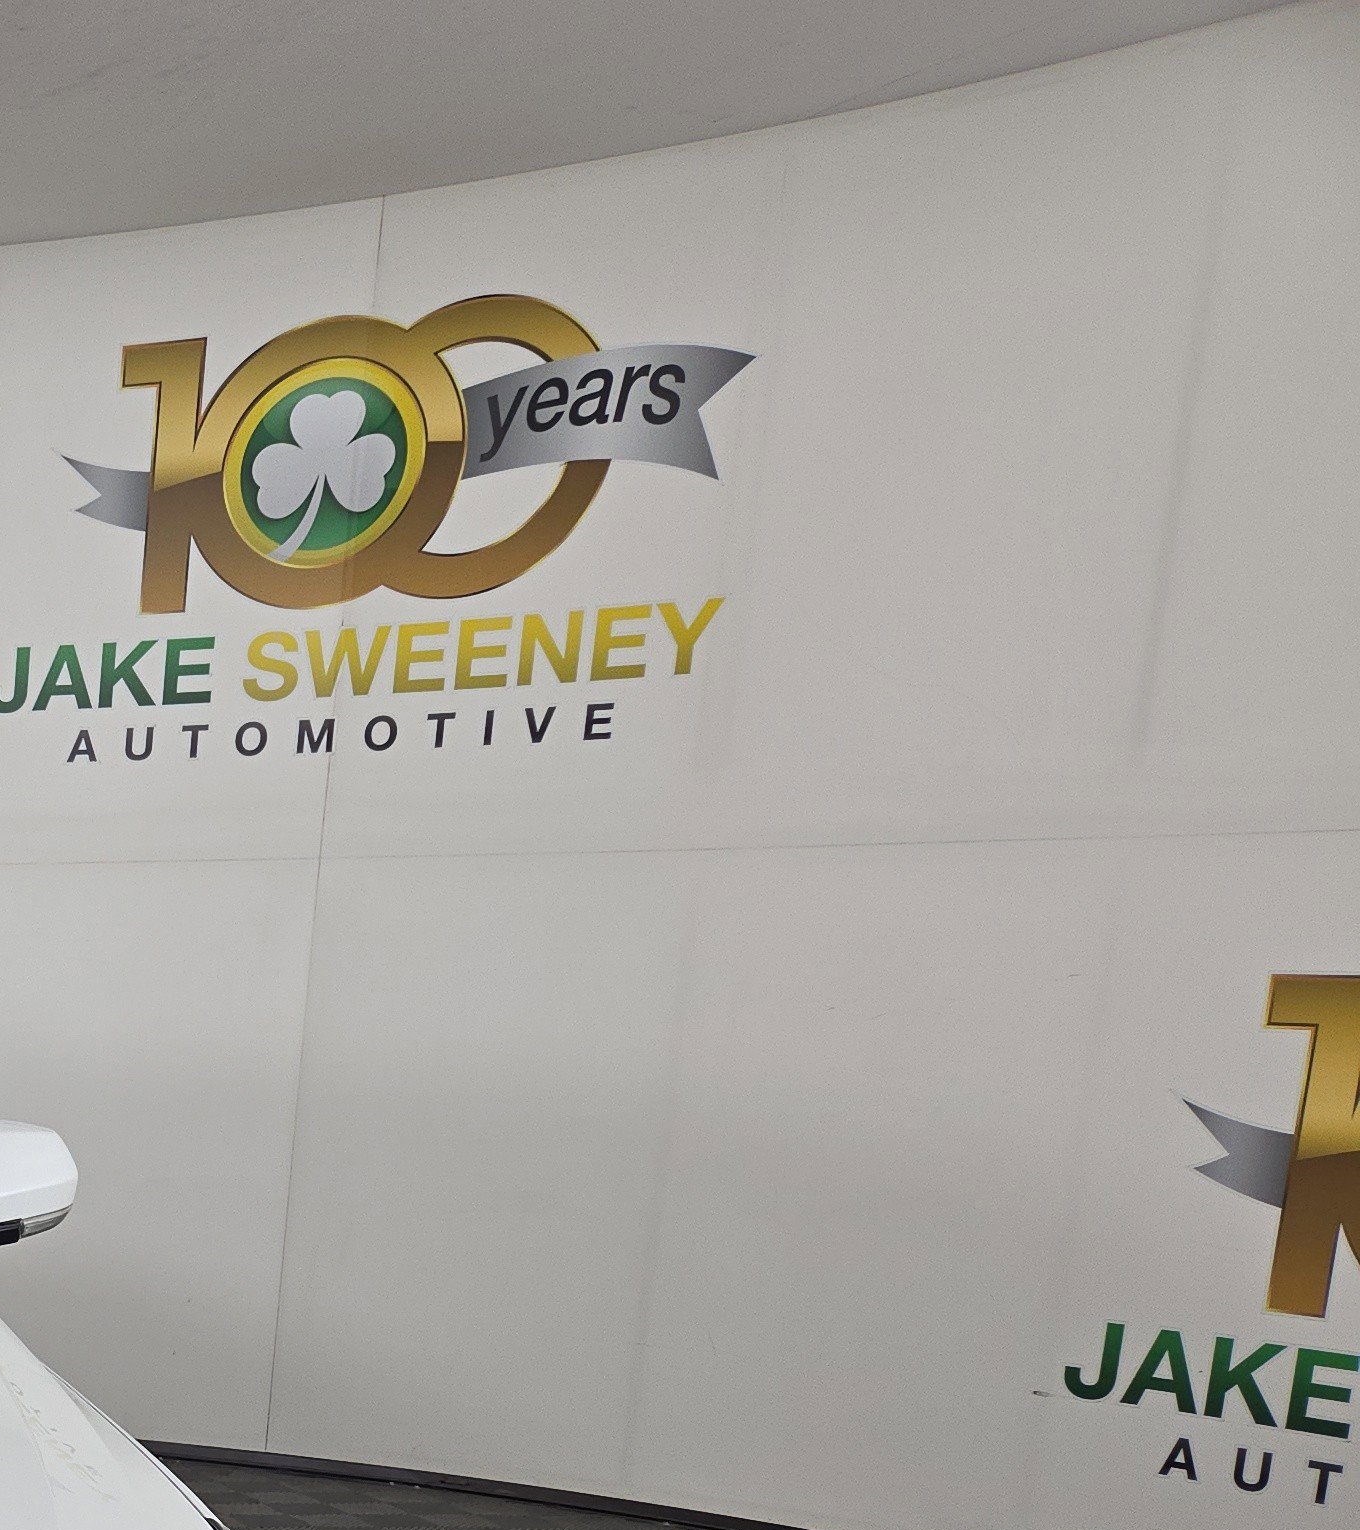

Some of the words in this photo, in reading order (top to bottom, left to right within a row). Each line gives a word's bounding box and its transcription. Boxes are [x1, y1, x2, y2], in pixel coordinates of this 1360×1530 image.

[121, 294, 612, 614] 100
[479, 362, 685, 462] years
[242, 597, 727, 702] SWEENEY
[66, 701, 616, 765] AUTOMOTIVE
[1063, 1321, 1360, 1440] JAKE
[1158, 1437, 1344, 1505] AUT
